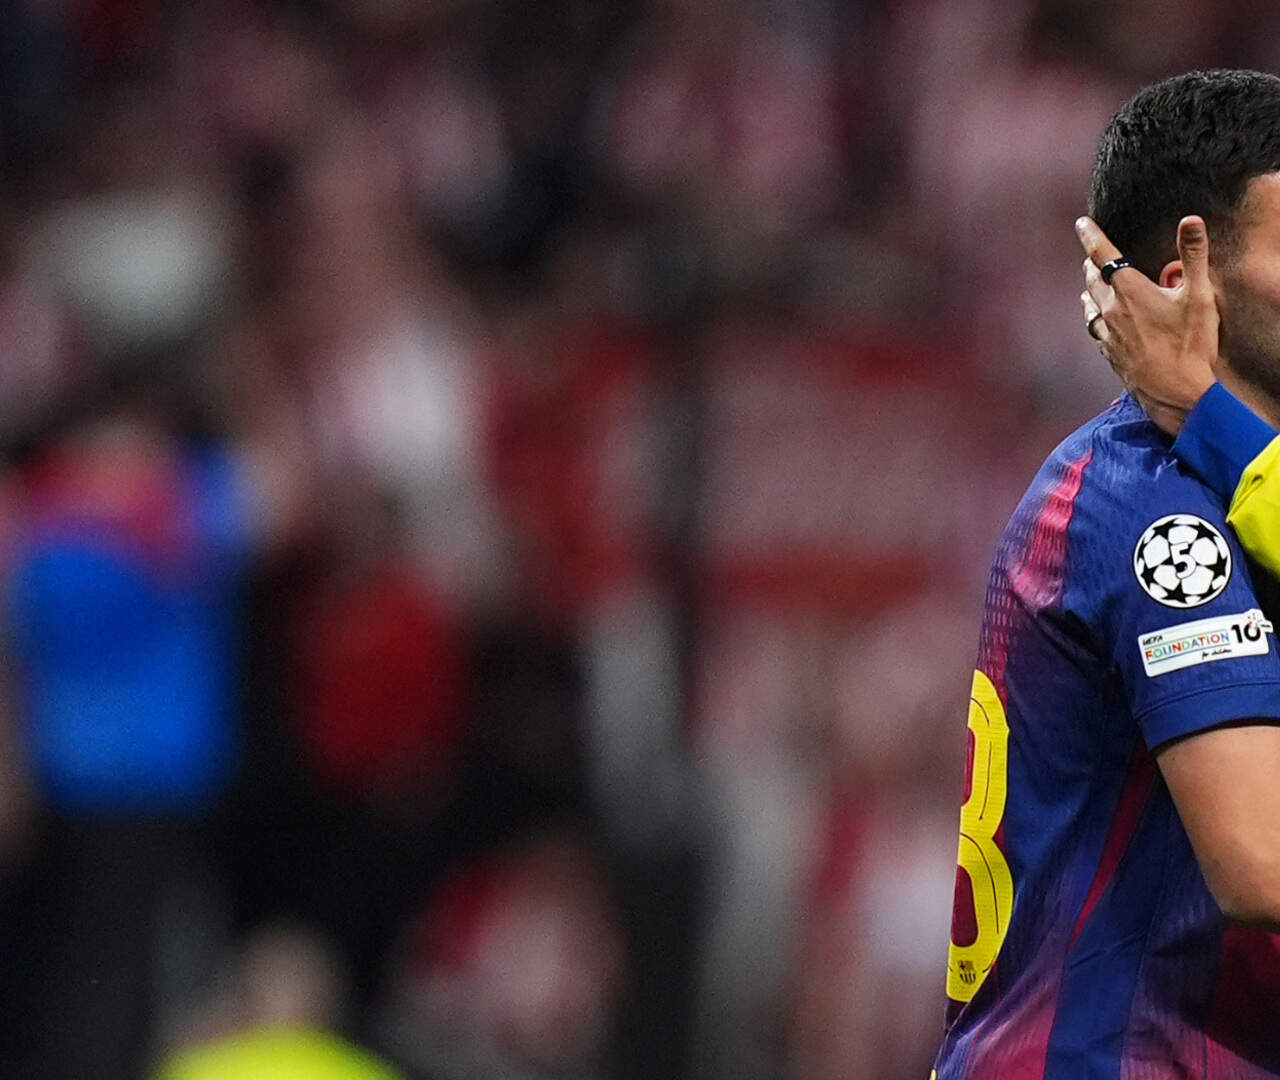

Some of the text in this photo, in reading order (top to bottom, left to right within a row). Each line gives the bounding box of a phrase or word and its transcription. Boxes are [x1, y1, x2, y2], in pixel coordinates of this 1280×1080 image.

[1170, 541, 1196, 579] 5
[1145, 632, 1230, 660] FOUNDATION
[1231, 620, 1261, 644] 10
